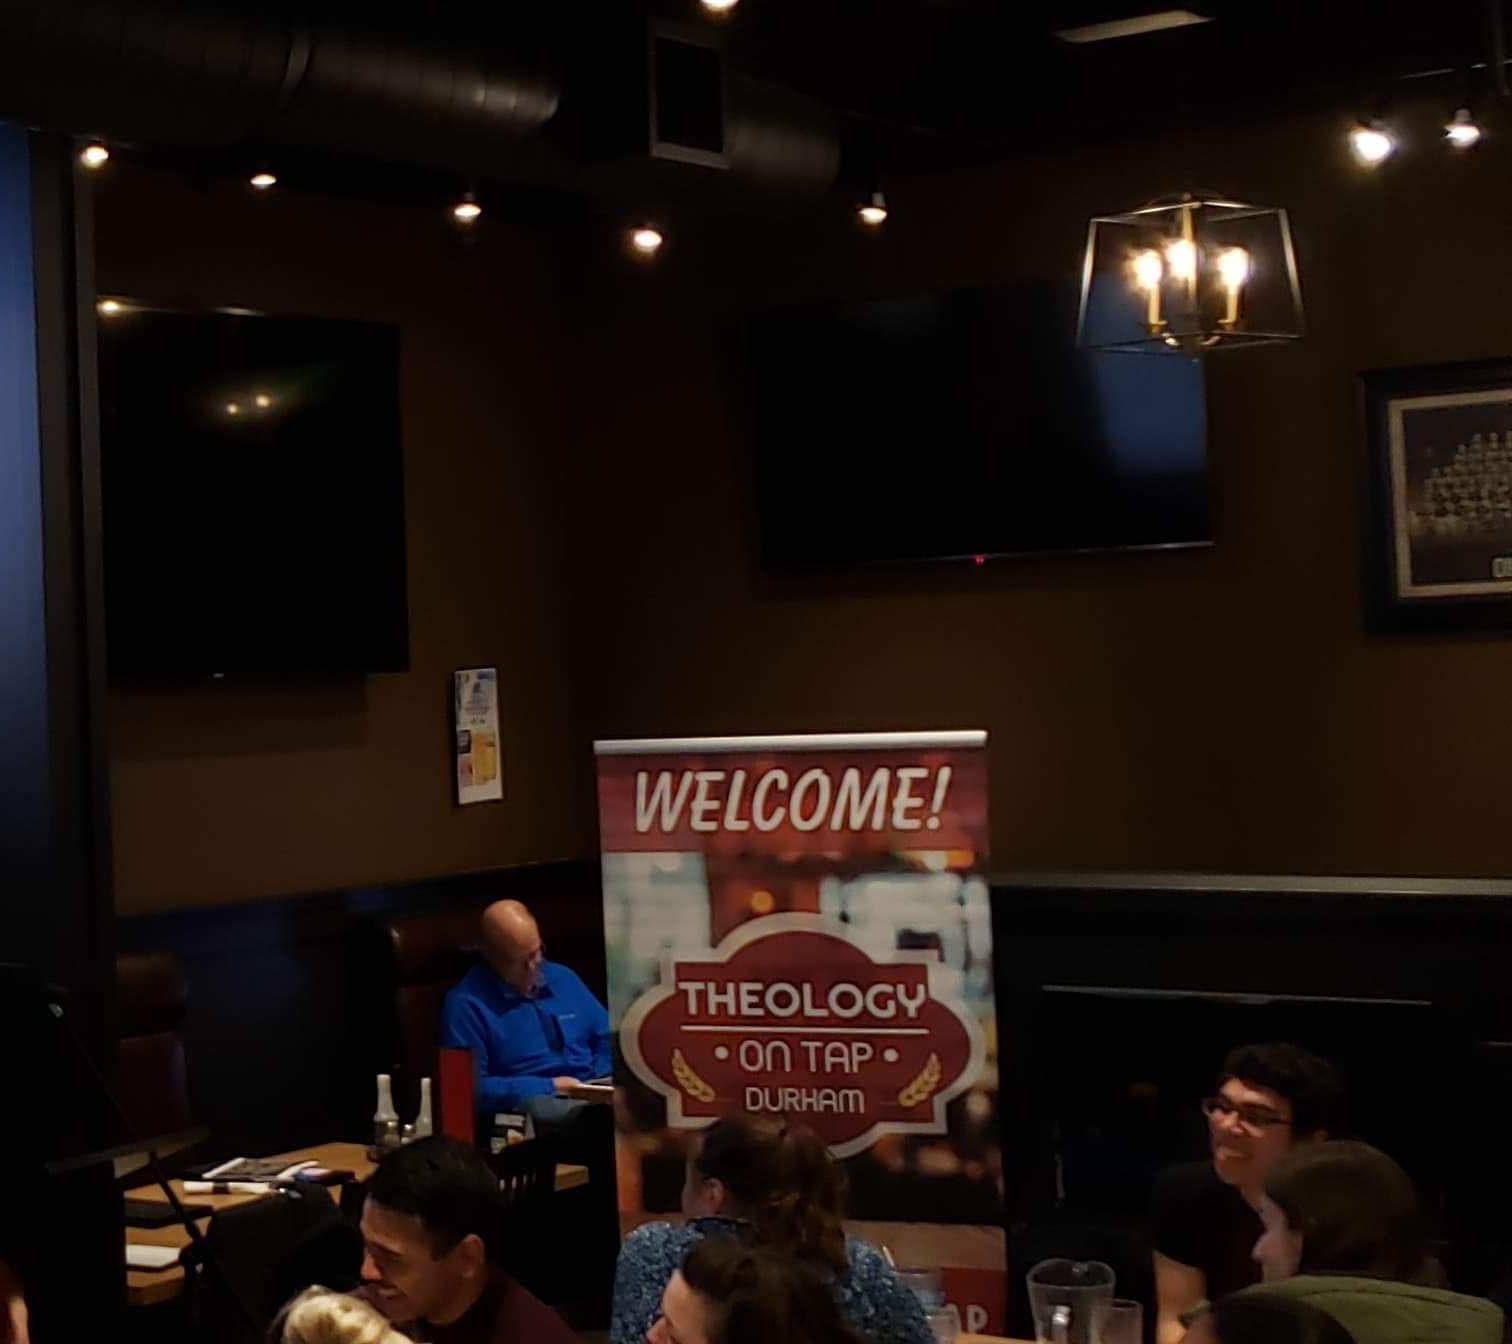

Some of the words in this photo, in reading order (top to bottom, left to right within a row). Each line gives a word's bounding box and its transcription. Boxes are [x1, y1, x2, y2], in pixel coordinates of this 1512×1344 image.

[635, 765, 953, 833] WELCOME!
[678, 981, 926, 1019] THEOLOGY
[739, 1039, 792, 1072] ON
[800, 1040, 874, 1074] TAP
[745, 1086, 865, 1114] DURHAM
